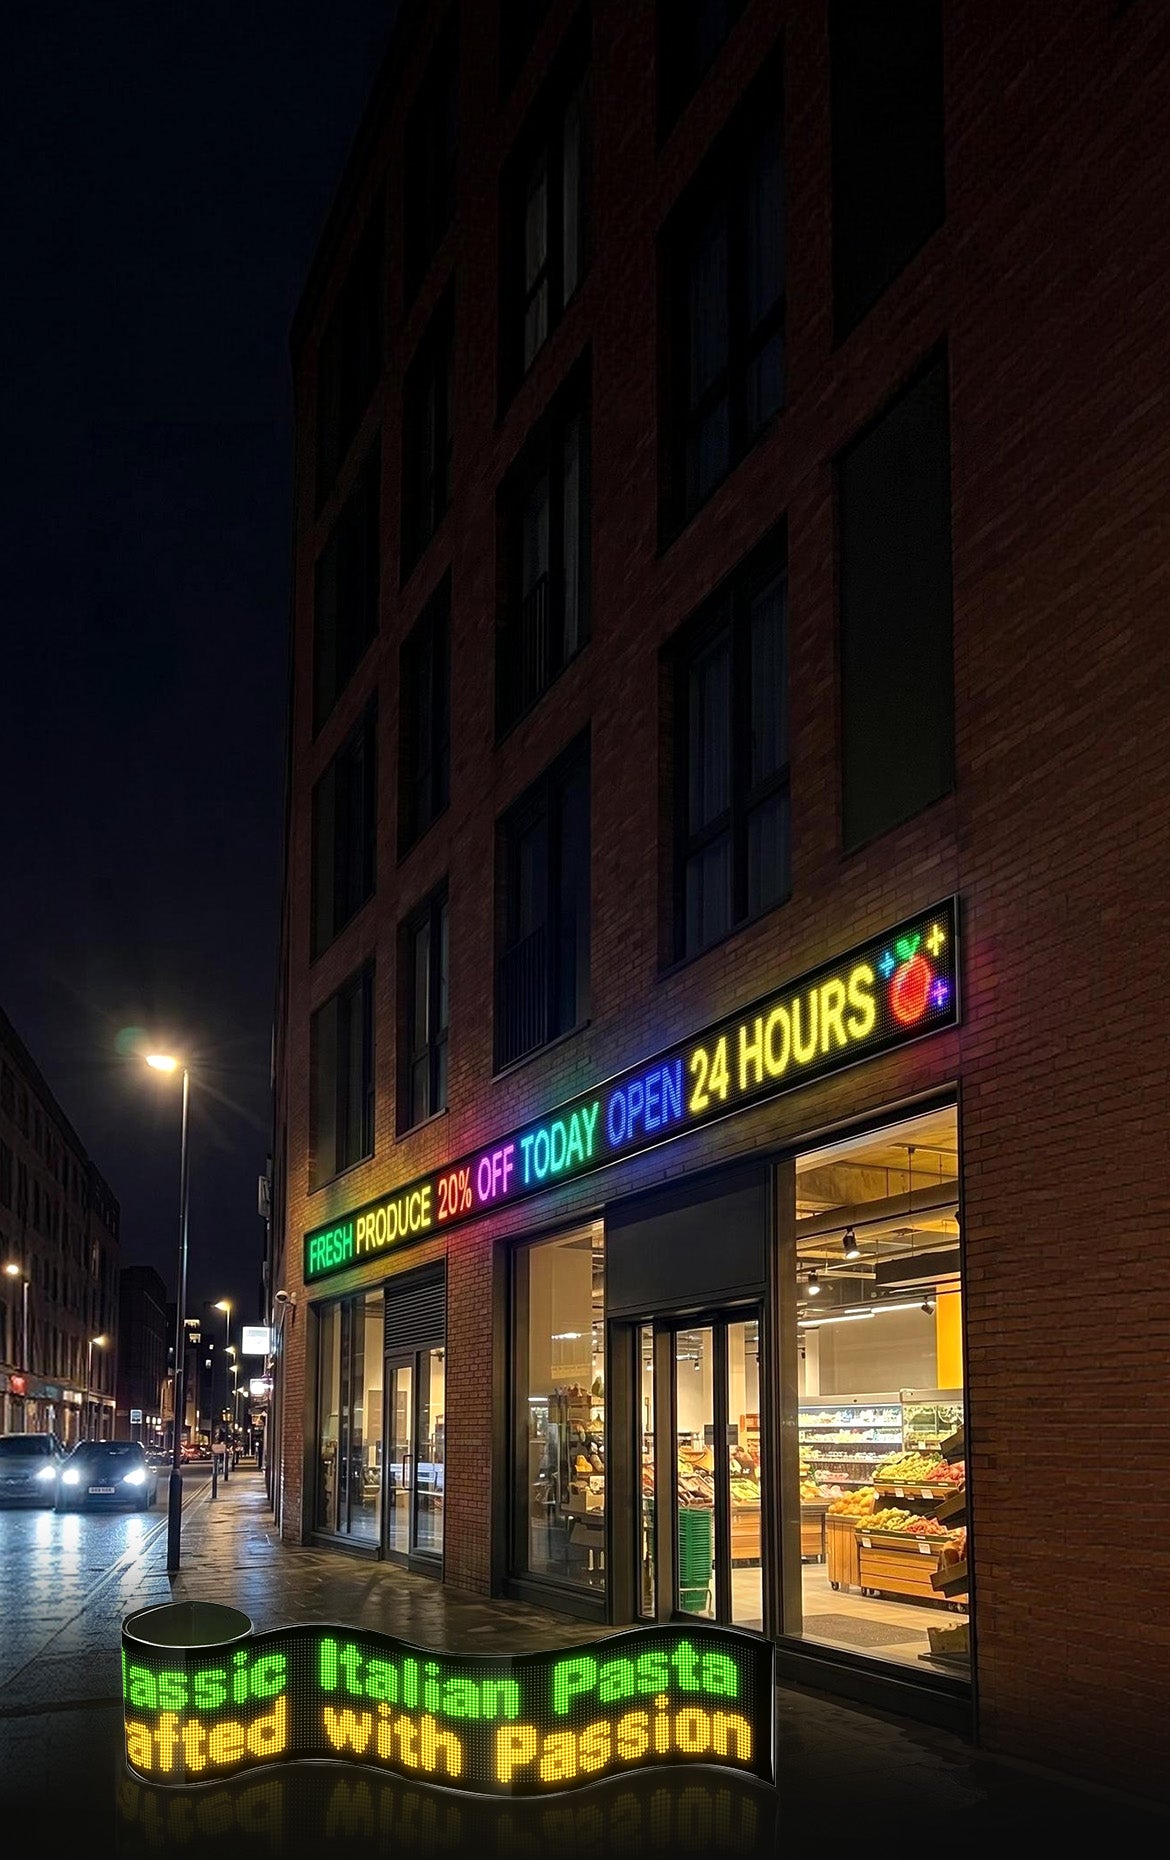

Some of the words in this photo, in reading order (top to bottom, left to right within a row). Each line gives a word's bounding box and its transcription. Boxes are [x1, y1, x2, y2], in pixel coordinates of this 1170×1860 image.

[309, 1222, 353, 1273] FRESH
[356, 1187, 431, 1254] PRODUCE
[438, 1168, 472, 1220] 20%
[477, 1145, 514, 1201] OFF
[520, 1102, 599, 1183] TODAY
[608, 1060, 683, 1146] OPEN
[690, 1037, 729, 1112] 24
[740, 965, 876, 1089] HOURS
[320, 1638, 519, 1719] Italian
[553, 1641, 738, 1714] Pasta
[125, 1695, 287, 1772] afted
[323, 1703, 462, 1776] with
[496, 1694, 752, 1783] Passion
